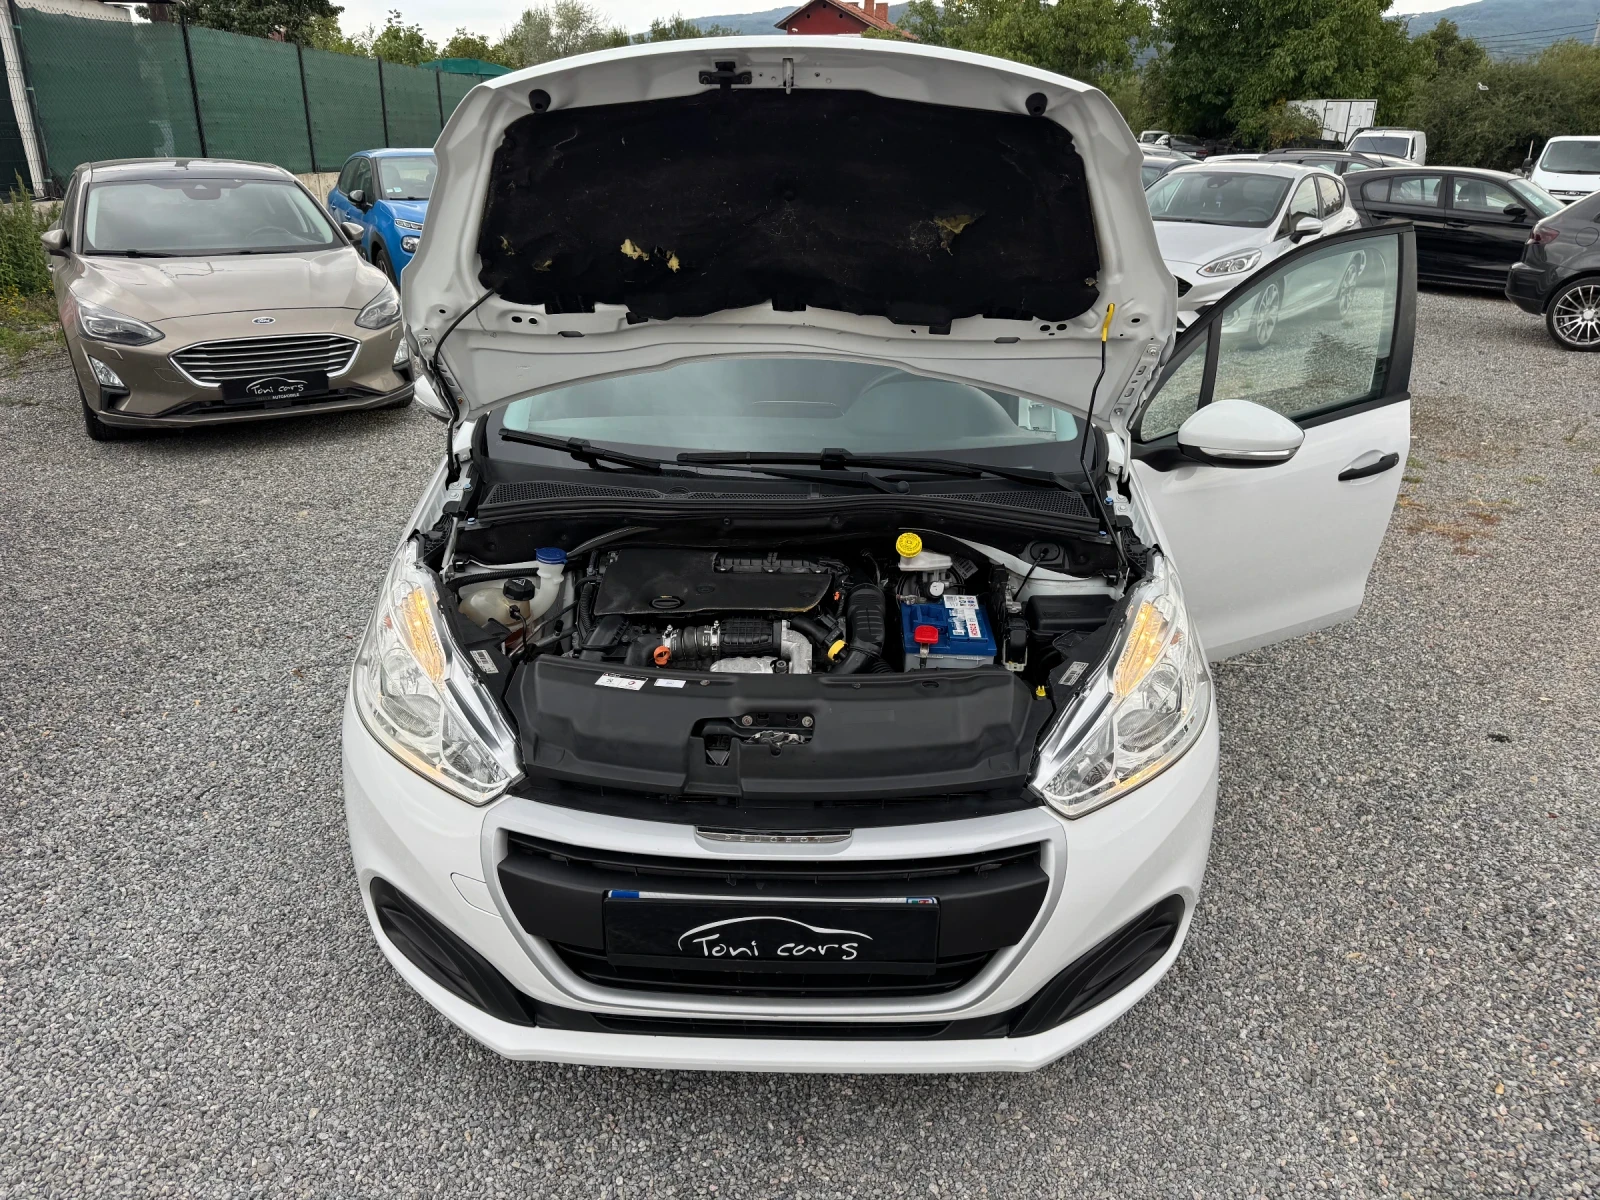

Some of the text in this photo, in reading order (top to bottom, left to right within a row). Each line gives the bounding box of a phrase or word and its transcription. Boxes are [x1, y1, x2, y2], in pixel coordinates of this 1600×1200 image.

[250, 384, 304, 395] Toni cars
[692, 933, 858, 960] Toni cars
